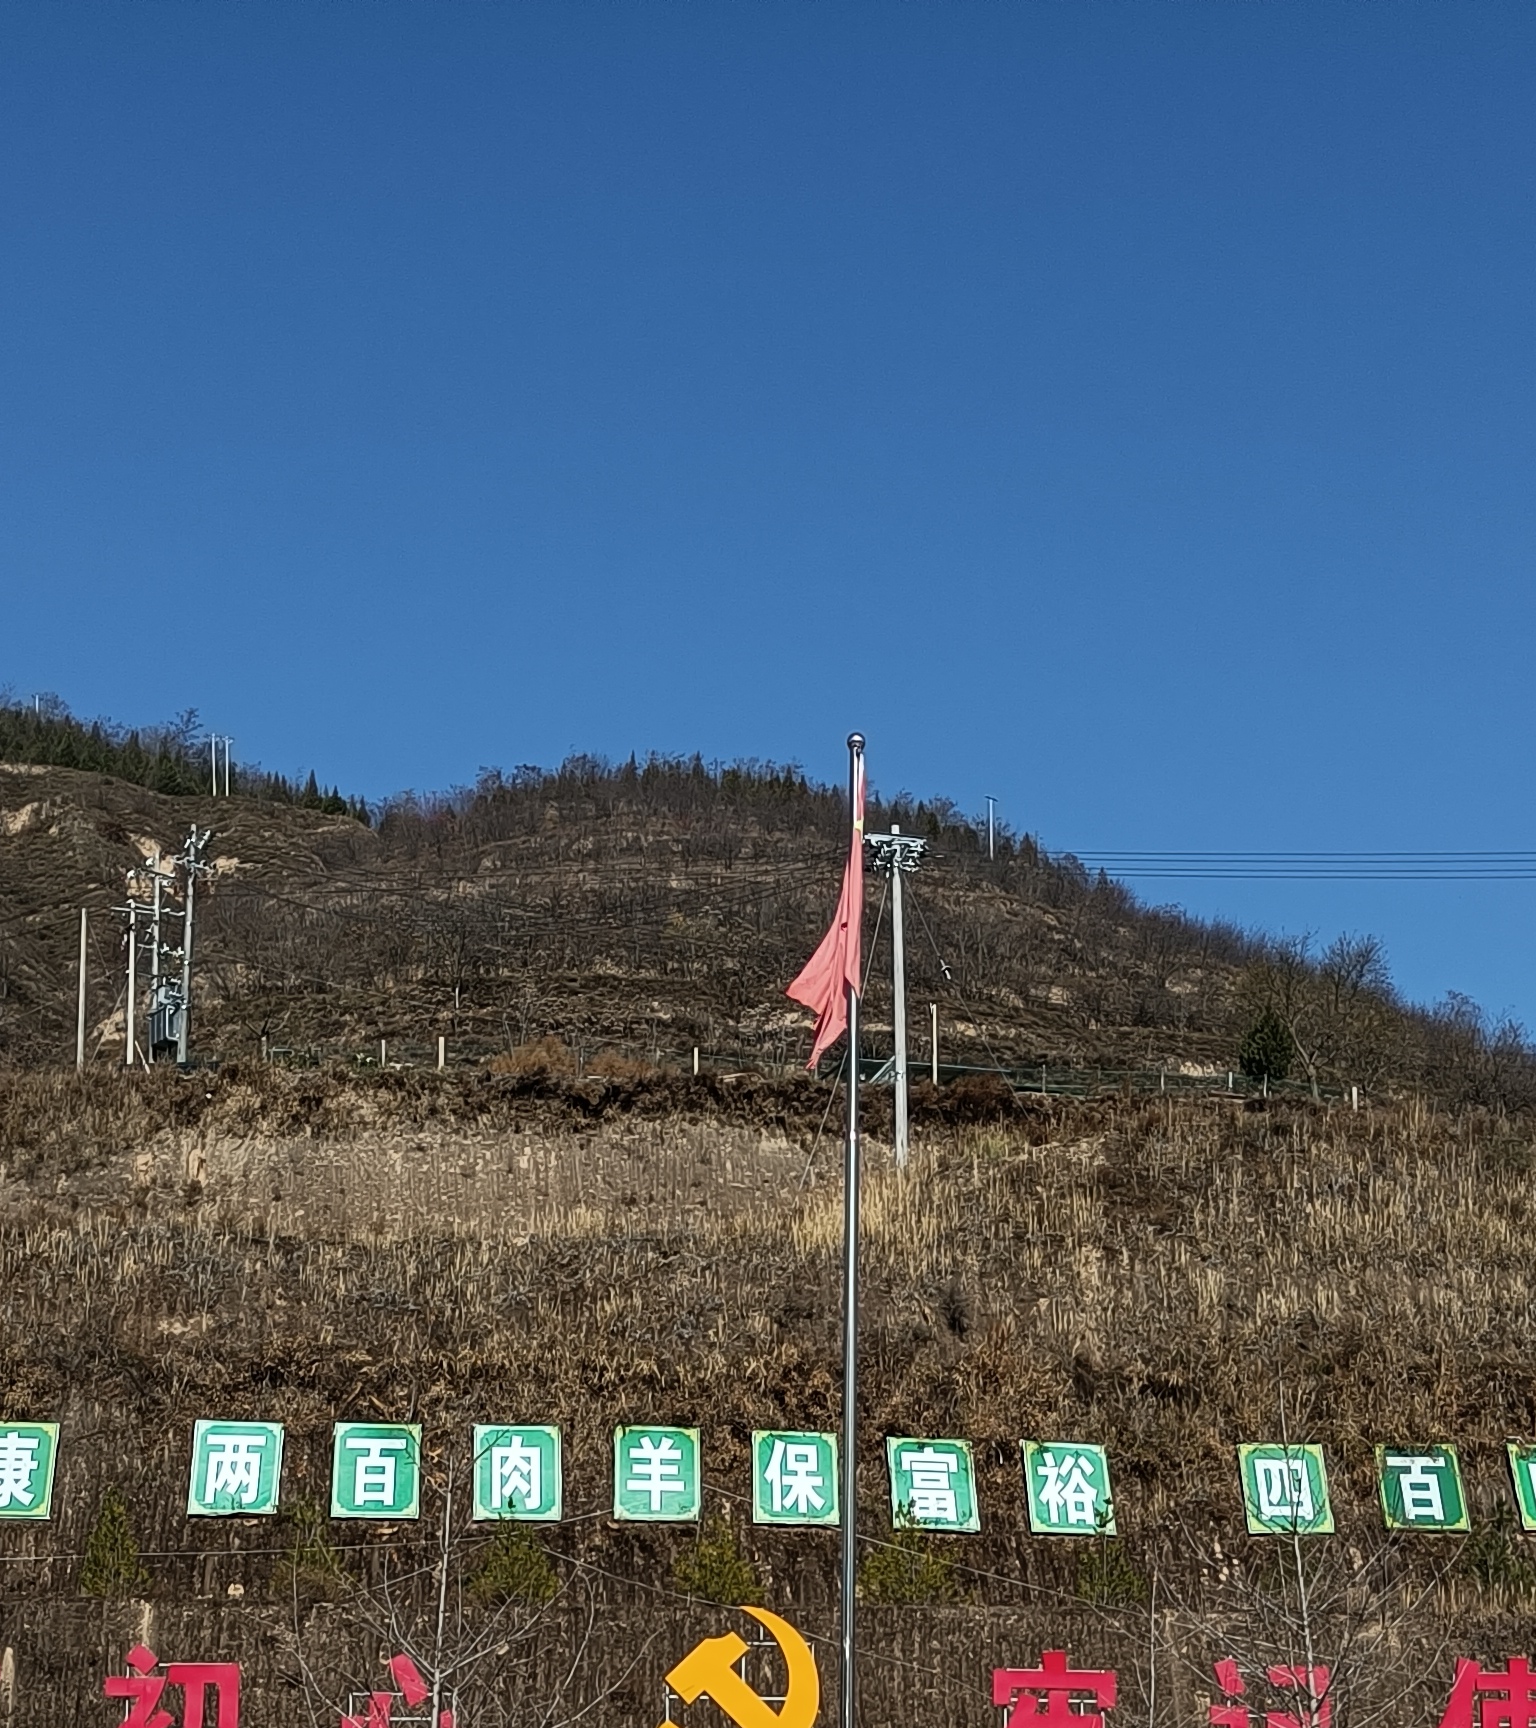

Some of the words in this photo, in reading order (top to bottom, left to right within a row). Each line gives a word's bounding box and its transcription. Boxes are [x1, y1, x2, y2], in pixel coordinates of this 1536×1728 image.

[203, 1433, 1099, 1526] 两百肉羊保富裕
